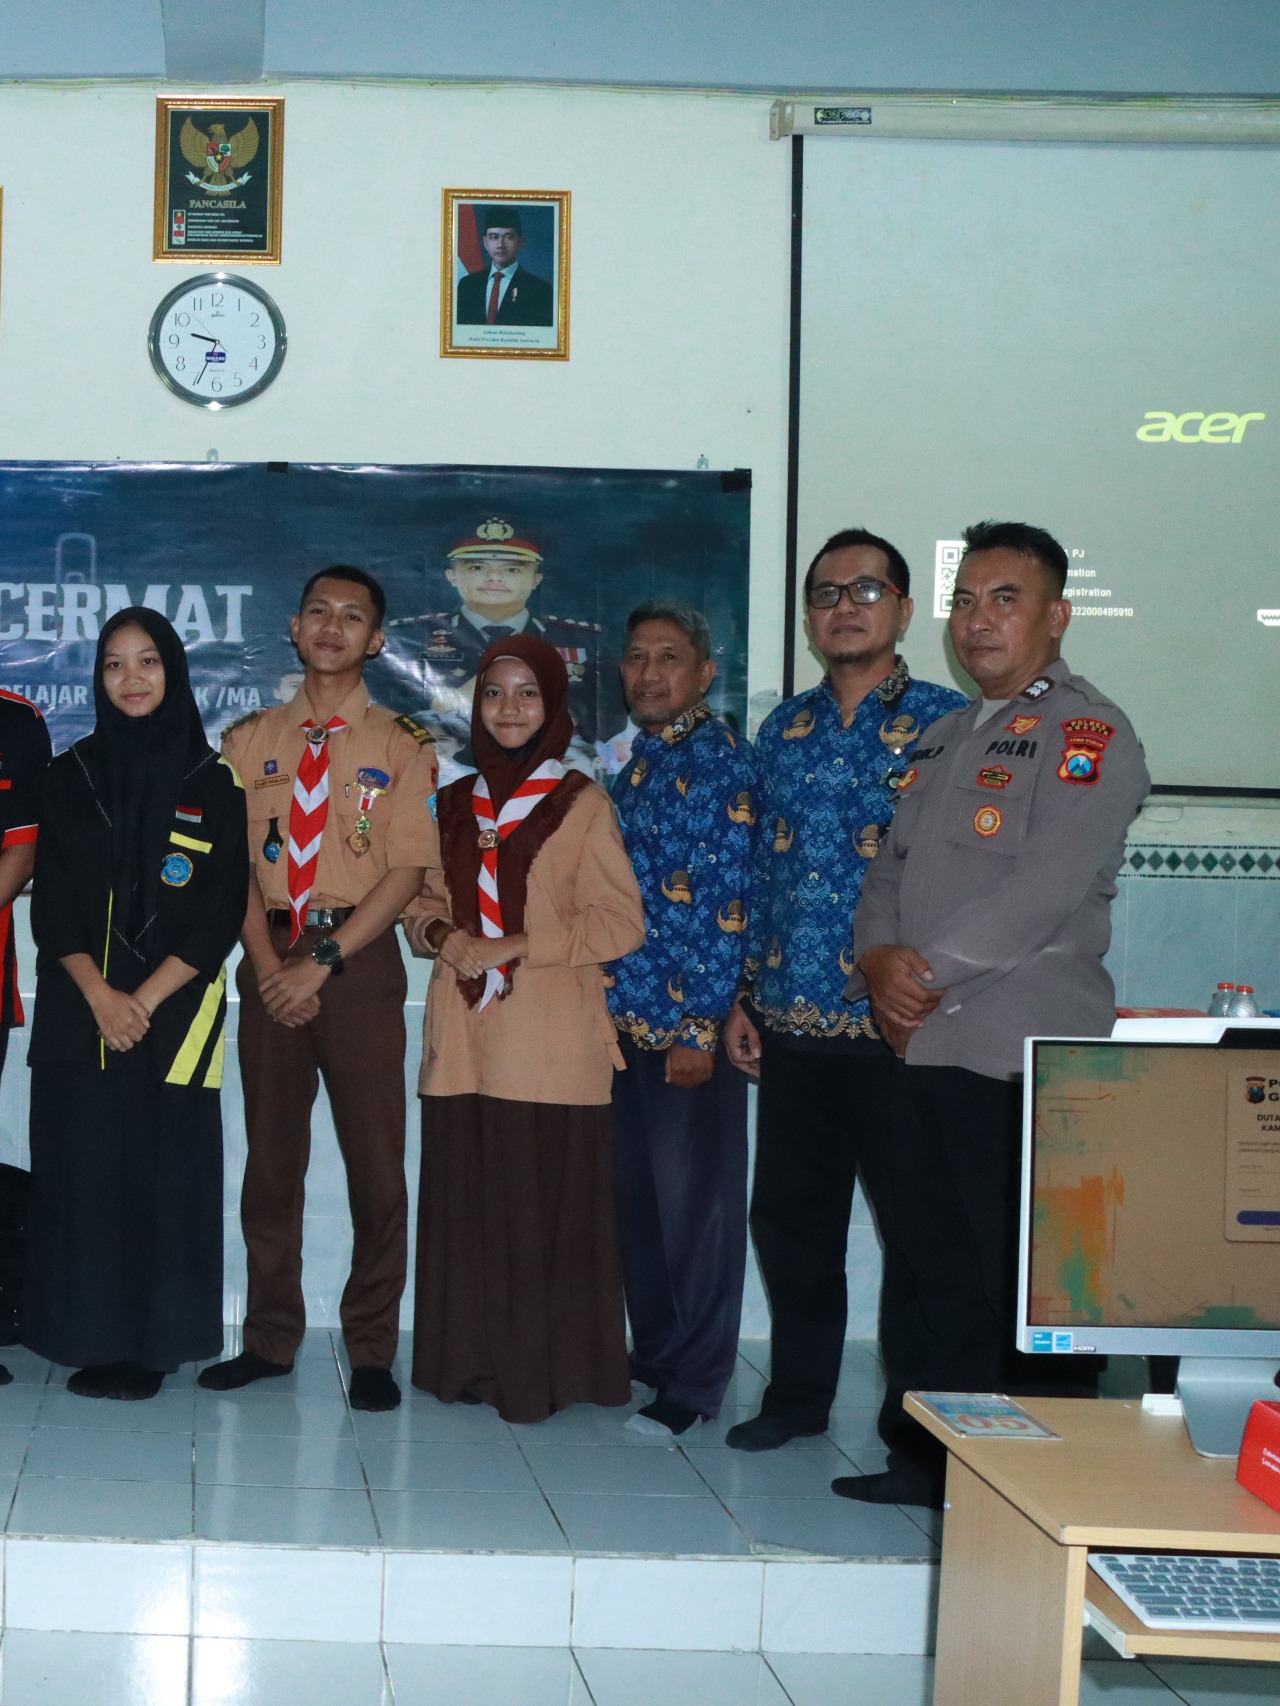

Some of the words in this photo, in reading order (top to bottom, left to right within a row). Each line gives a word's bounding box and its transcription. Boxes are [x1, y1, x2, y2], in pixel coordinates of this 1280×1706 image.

[189, 200, 247, 209] PANCASILA
[193, 297, 202, 311] 11
[211, 293, 224, 307] 12
[174, 312, 191, 327] 10
[250, 312, 260, 328] 2
[168, 333, 180, 349] 9
[256, 334, 267, 350] 3
[175, 356, 186, 371] 8
[248, 356, 258, 371] 4
[211, 376, 223, 392] 6
[233, 371, 243, 387] 5
[1136, 411, 1266, 444] acer
[1072, 549, 1085, 558] PJ
[1062, 587, 1112, 598] egistration
[1071, 606, 1134, 617] 322000485910
[1071, 720, 1106, 731] POLRES
[985, 740, 1038, 759] POLRI
